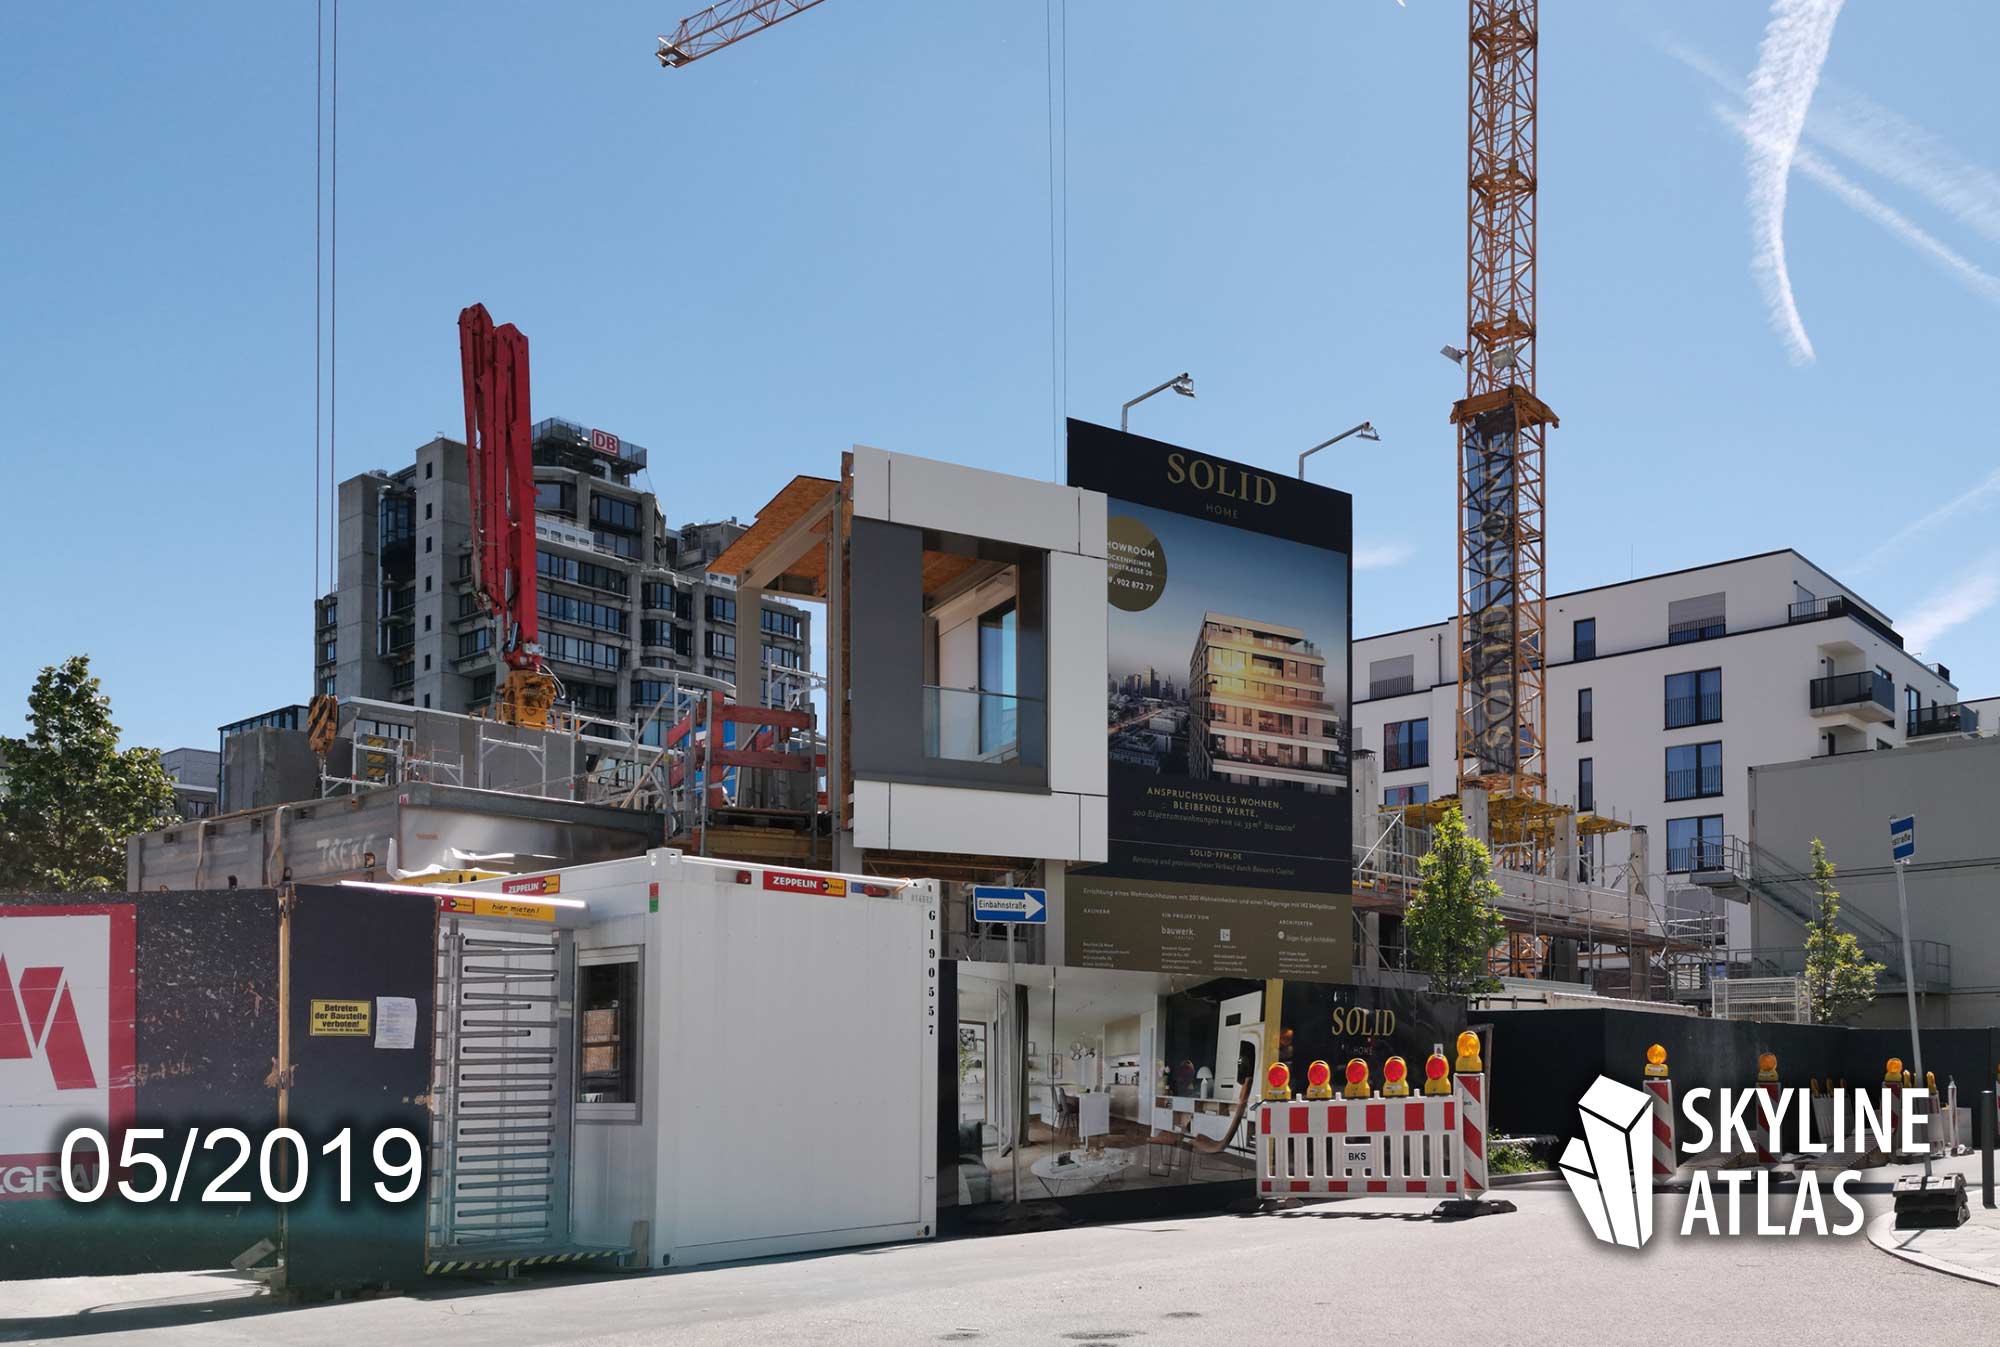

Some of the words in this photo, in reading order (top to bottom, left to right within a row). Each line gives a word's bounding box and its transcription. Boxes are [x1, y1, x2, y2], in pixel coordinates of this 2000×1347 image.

[595, 432, 616, 451] DB
[1167, 453, 1277, 506] SOLID
[1206, 503, 1239, 519] HOME
[1106, 541, 1155, 558] HOWROOM
[1107, 554, 1152, 568] OCKENHEIMER
[1147, 787, 1237, 804] ANSPRUCHSVOLLES
[1240, 797, 1283, 810] WOHNEN.
[1173, 801, 1223, 814] BLEIBENDE
[1226, 807, 1259, 818] WERTE.
[1189, 849, 1242, 860] SOLID-FFM.DE
[508, 883, 539, 894] ZEPPELIN
[773, 876, 818, 889] ZEPPELIN
[492, 903, 508, 911] hier
[511, 904, 540, 914] mieten!
[979, 900, 1027, 910] Einbahnstraße
[325, 1004, 358, 1012] Betreten
[330, 1012, 367, 1020] Baustelle
[1331, 1006, 1396, 1036] SOLID
[322, 1019, 360, 1028] verboten!
[1353, 1046, 1373, 1056] HOME
[1348, 1152, 1367, 1161] BKS
